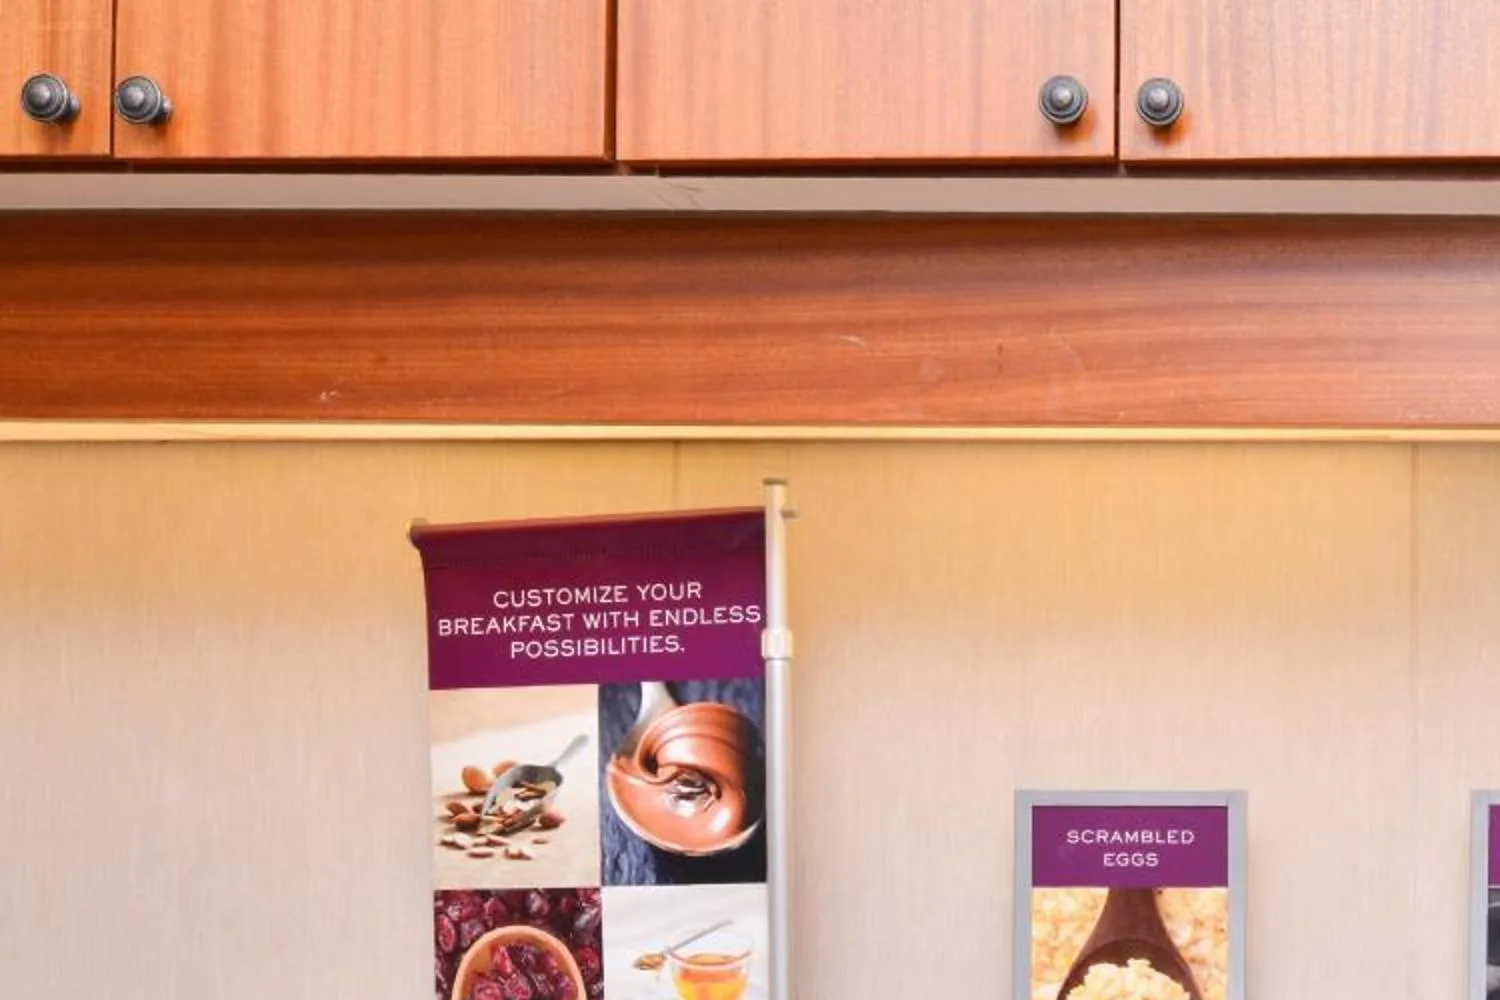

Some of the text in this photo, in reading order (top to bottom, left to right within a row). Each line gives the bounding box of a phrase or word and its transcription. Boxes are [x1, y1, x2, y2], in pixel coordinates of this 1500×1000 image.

[493, 581, 702, 609] CUSTOMIZE YOUR
[438, 605, 762, 637] BREAKFAST WITH ENDLESS
[511, 635, 685, 659] POSSIBILITIES.
[1066, 829, 1195, 845] SCRAMBLED
[1103, 852, 1159, 867] EGGS
